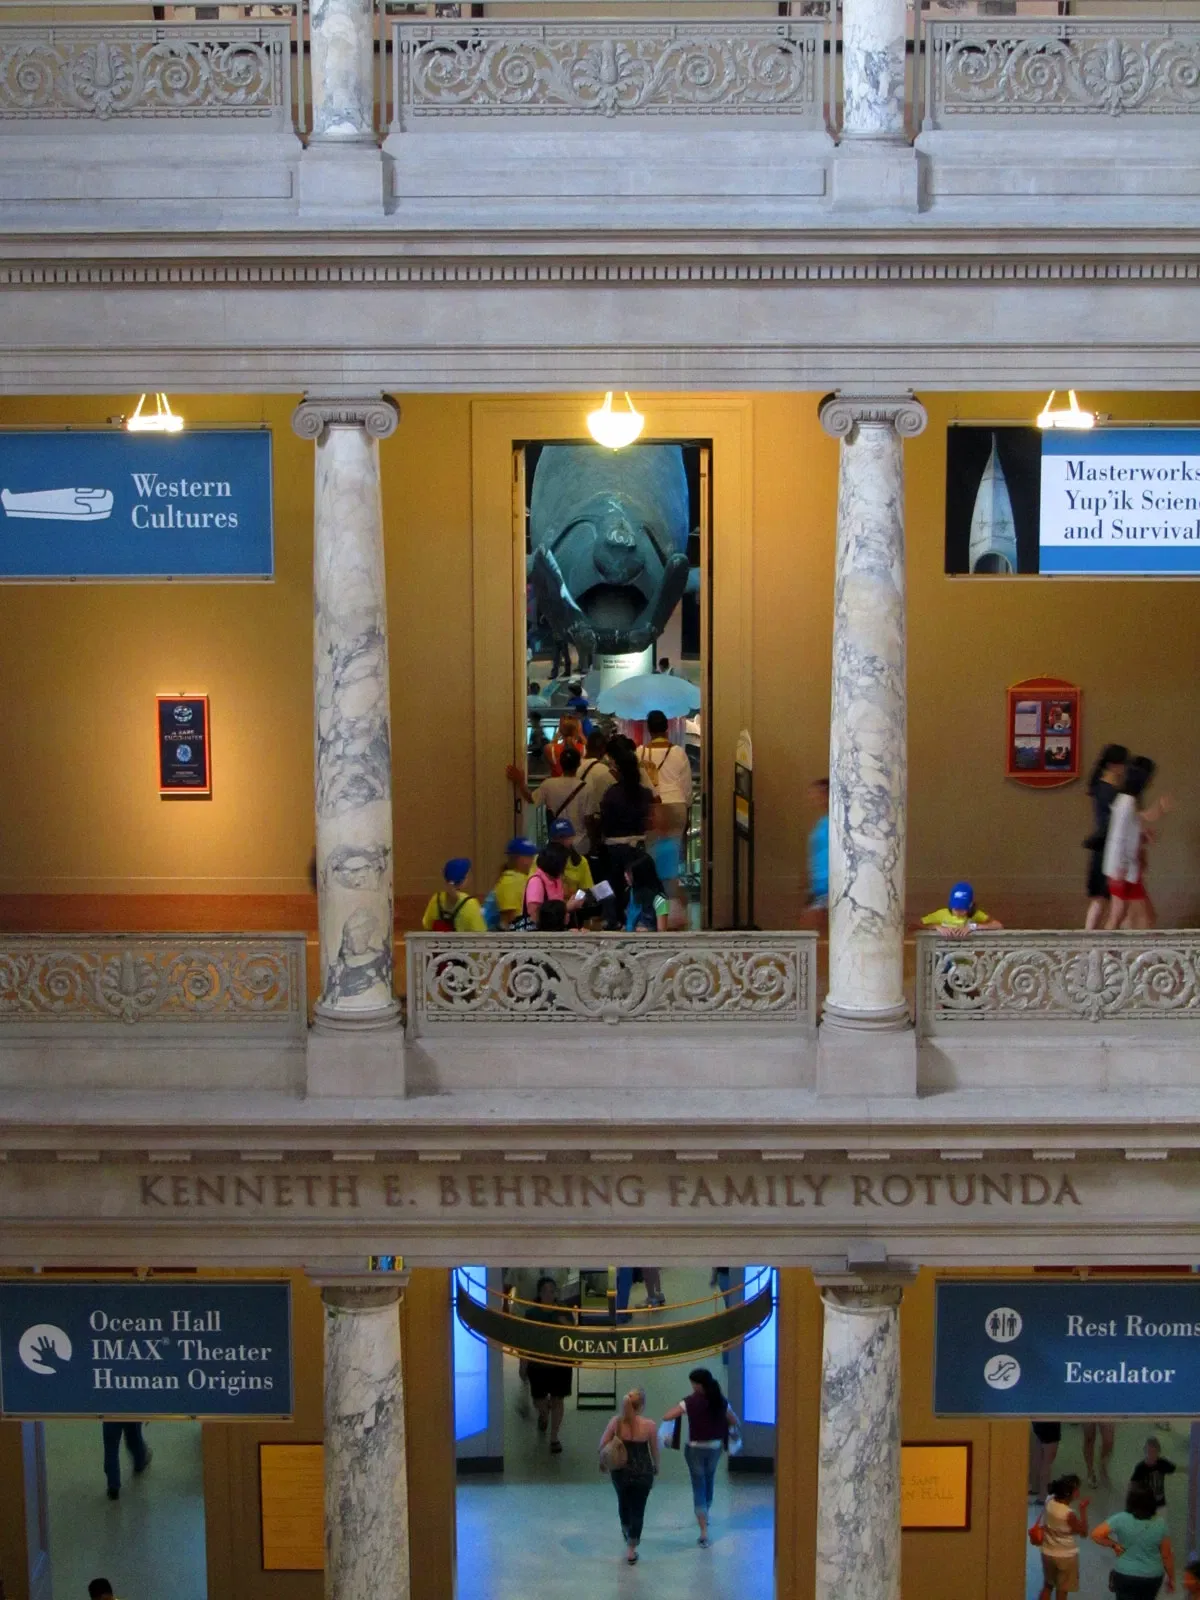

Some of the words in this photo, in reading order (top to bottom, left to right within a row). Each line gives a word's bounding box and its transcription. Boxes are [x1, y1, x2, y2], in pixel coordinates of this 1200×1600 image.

[131, 472, 233, 498] Western
[1141, 489, 1200, 511] Scien
[131, 504, 239, 529] Cultures
[1064, 519, 1103, 540] and
[1111, 518, 1200, 540] Survival
[138, 1174, 362, 1208] KENNETH
[382, 1174, 418, 1208] E.
[438, 1174, 647, 1208] BEHRING
[667, 1173, 832, 1207] FAMILY
[850, 1173, 1083, 1207] ROTUNDA
[89, 1310, 163, 1332] Ocean
[170, 1310, 222, 1332] Hall
[1066, 1315, 1117, 1337] Rest
[1125, 1315, 1200, 1337] Rooms
[177, 1339, 272, 1361] Theater
[559, 1335, 618, 1354] OCEAN
[622, 1336, 669, 1354] HALL
[92, 1368, 179, 1389] Human
[187, 1368, 274, 1396] Origins
[1064, 1361, 1176, 1384] Escalator
